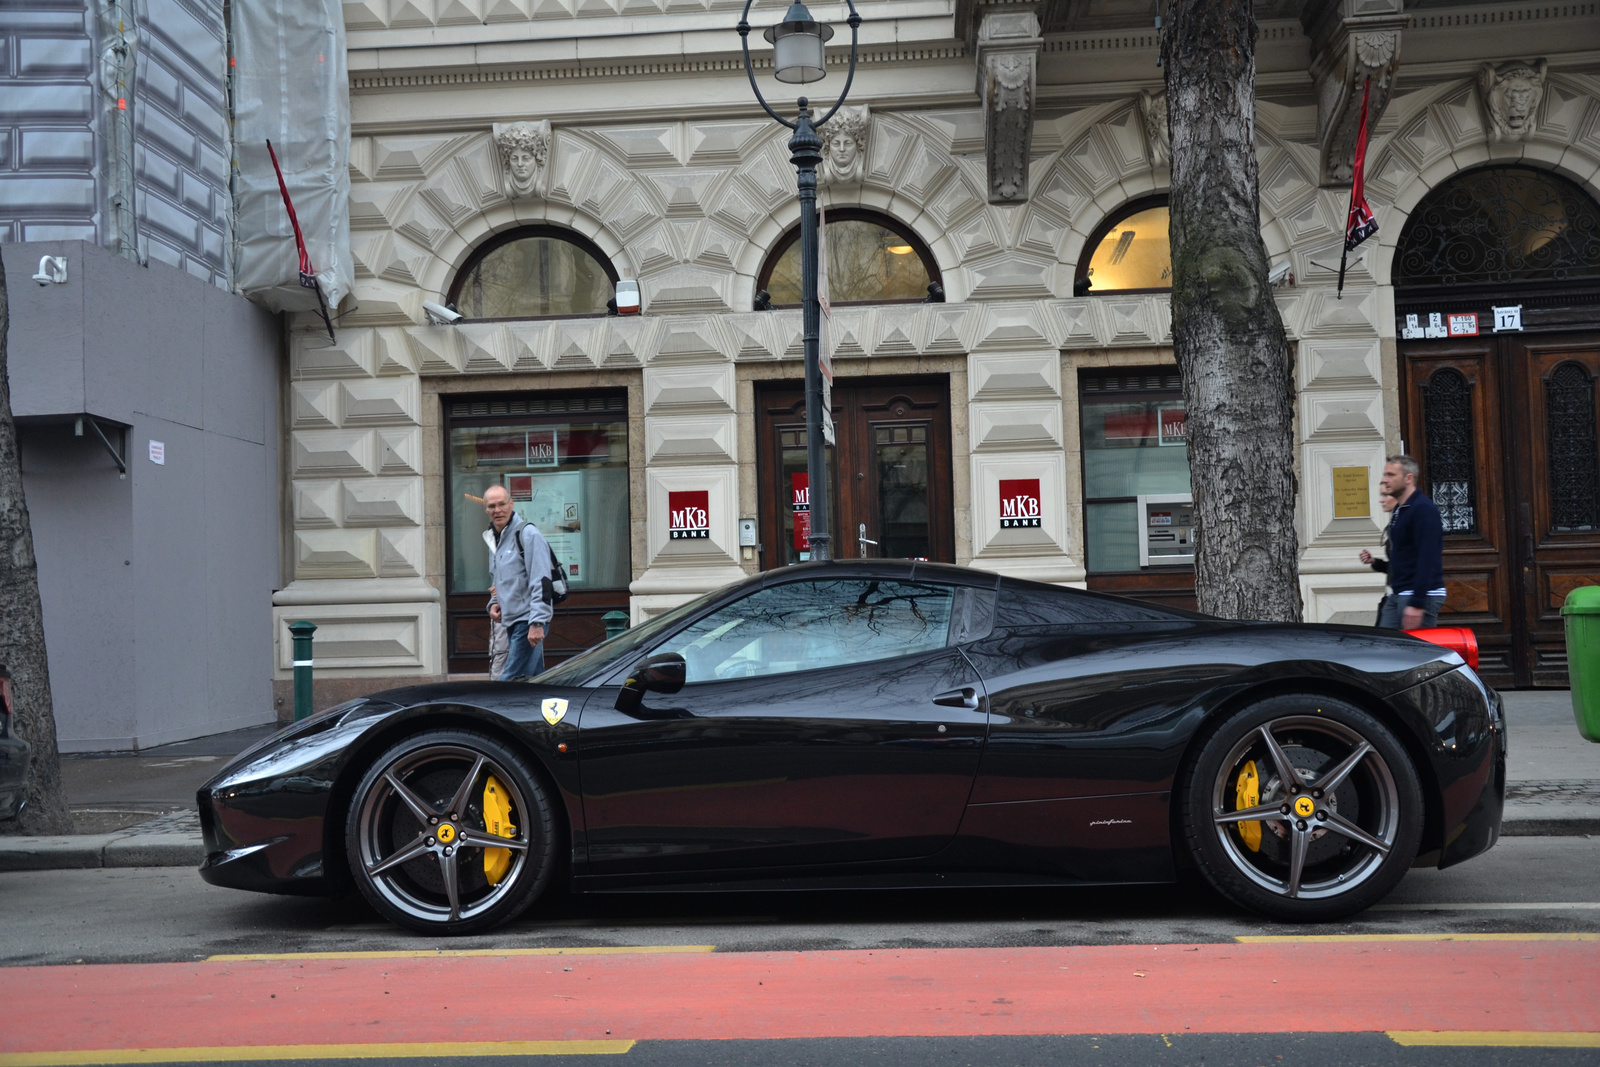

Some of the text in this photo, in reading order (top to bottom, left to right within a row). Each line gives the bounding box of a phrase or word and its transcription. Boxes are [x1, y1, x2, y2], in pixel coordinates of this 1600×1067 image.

[1500, 315, 1515, 328] 17
[530, 443, 552, 458] MKB
[1002, 495, 1039, 518] MKB
[672, 506, 707, 530] MKB
[1004, 519, 1038, 527] BANK
[673, 530, 706, 539] BANK
